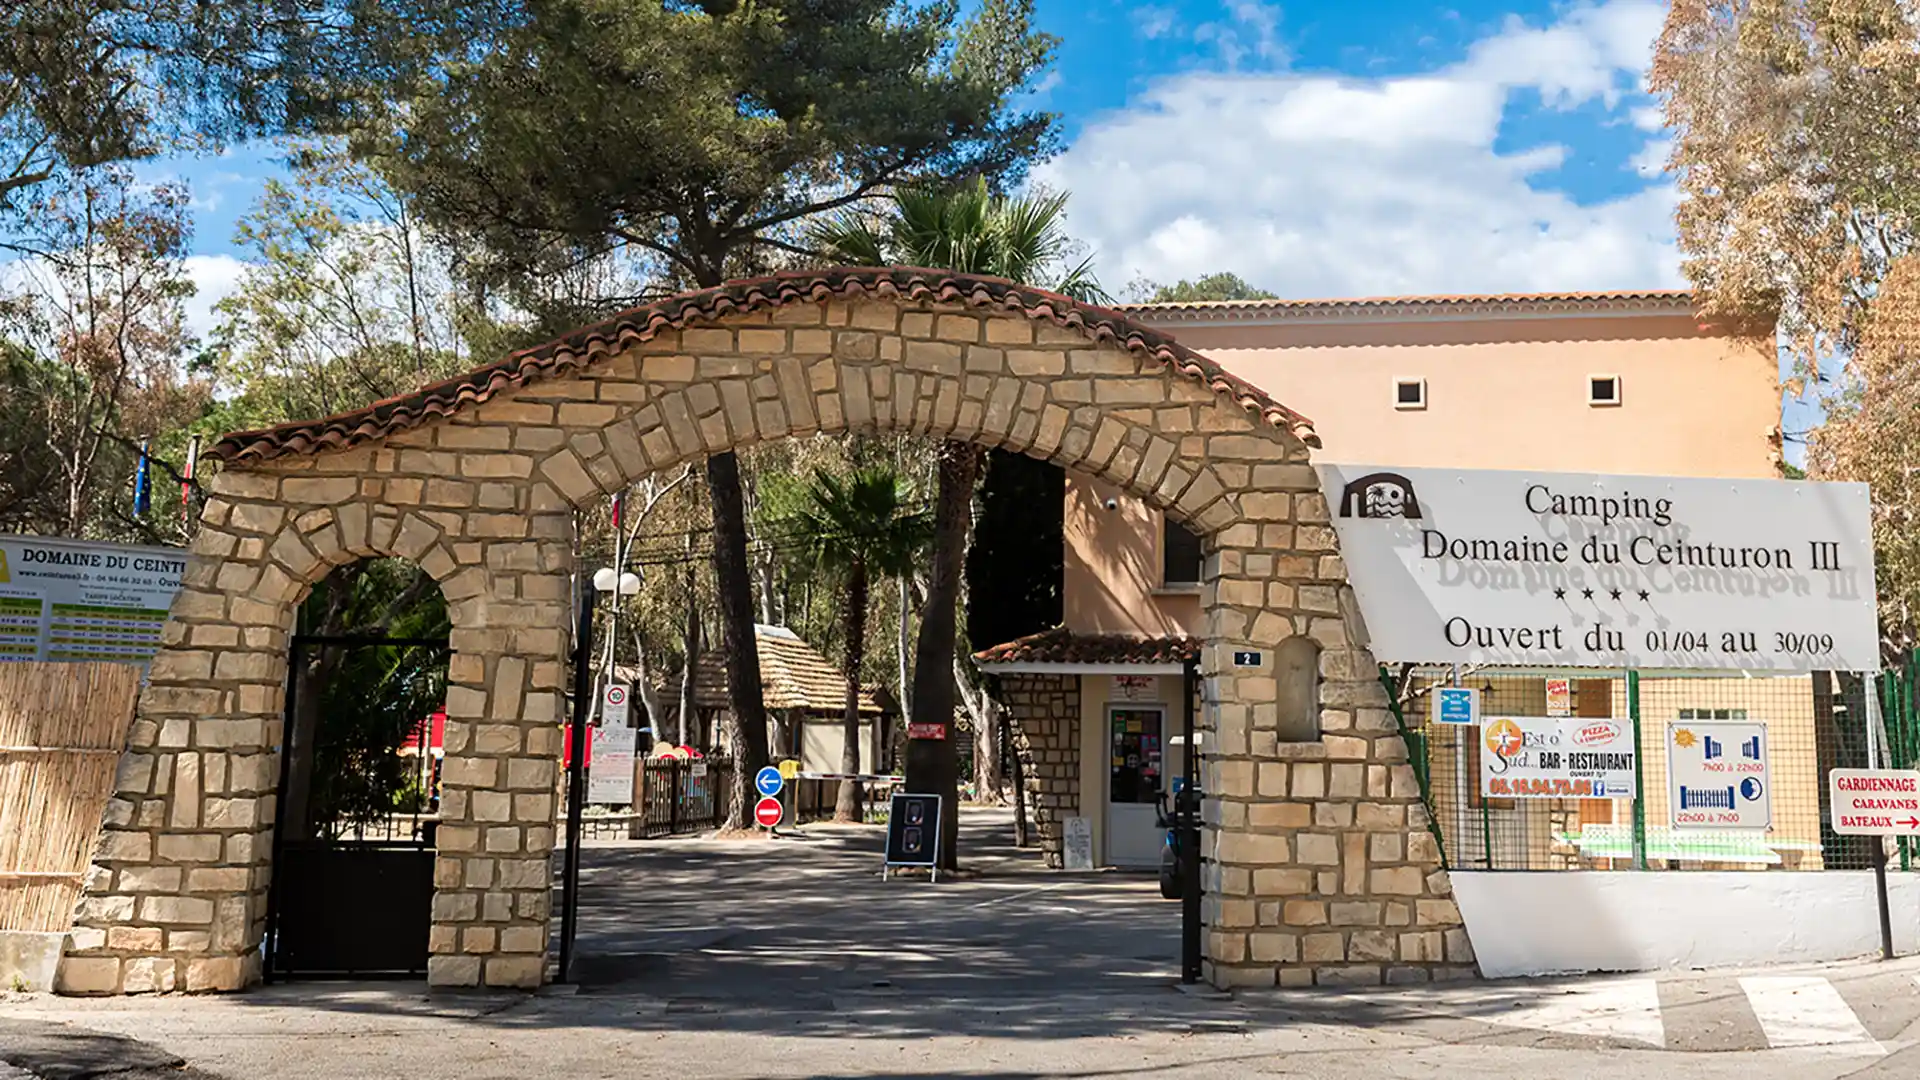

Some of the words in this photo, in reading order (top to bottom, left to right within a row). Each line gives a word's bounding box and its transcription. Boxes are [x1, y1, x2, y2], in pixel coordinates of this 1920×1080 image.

[1525, 484, 1673, 527] Camping
[1422, 528, 1568, 563] Domaine
[1581, 535, 1620, 564] du
[1630, 535, 1793, 569] Ceinturon
[1809, 541, 1841, 571] III
[22, 548, 101, 567] DOMAINE
[106, 555, 129, 569] DU
[1444, 616, 1563, 650] Ouvert
[1584, 622, 1624, 653] du
[1645, 630, 1709, 654] 01/04
[1721, 634, 1757, 653] au
[1773, 632, 1835, 655] 30/09
[1244, 653, 1251, 665] 2
[1582, 726, 1611, 736] PIZZA
[1540, 752, 1561, 769] BAR
[1568, 752, 1634, 771] RESTAURANT
[1702, 763, 1725, 772] 7h00
[1736, 763, 1764, 773] 22h00
[1837, 776, 1917, 792] GARDIENNAGE
[1852, 798, 1919, 810] CARAVANES
[1677, 813, 1705, 823] 22h00
[1717, 813, 1740, 823] 7h00
[1840, 815, 1893, 827] BATEAUX
